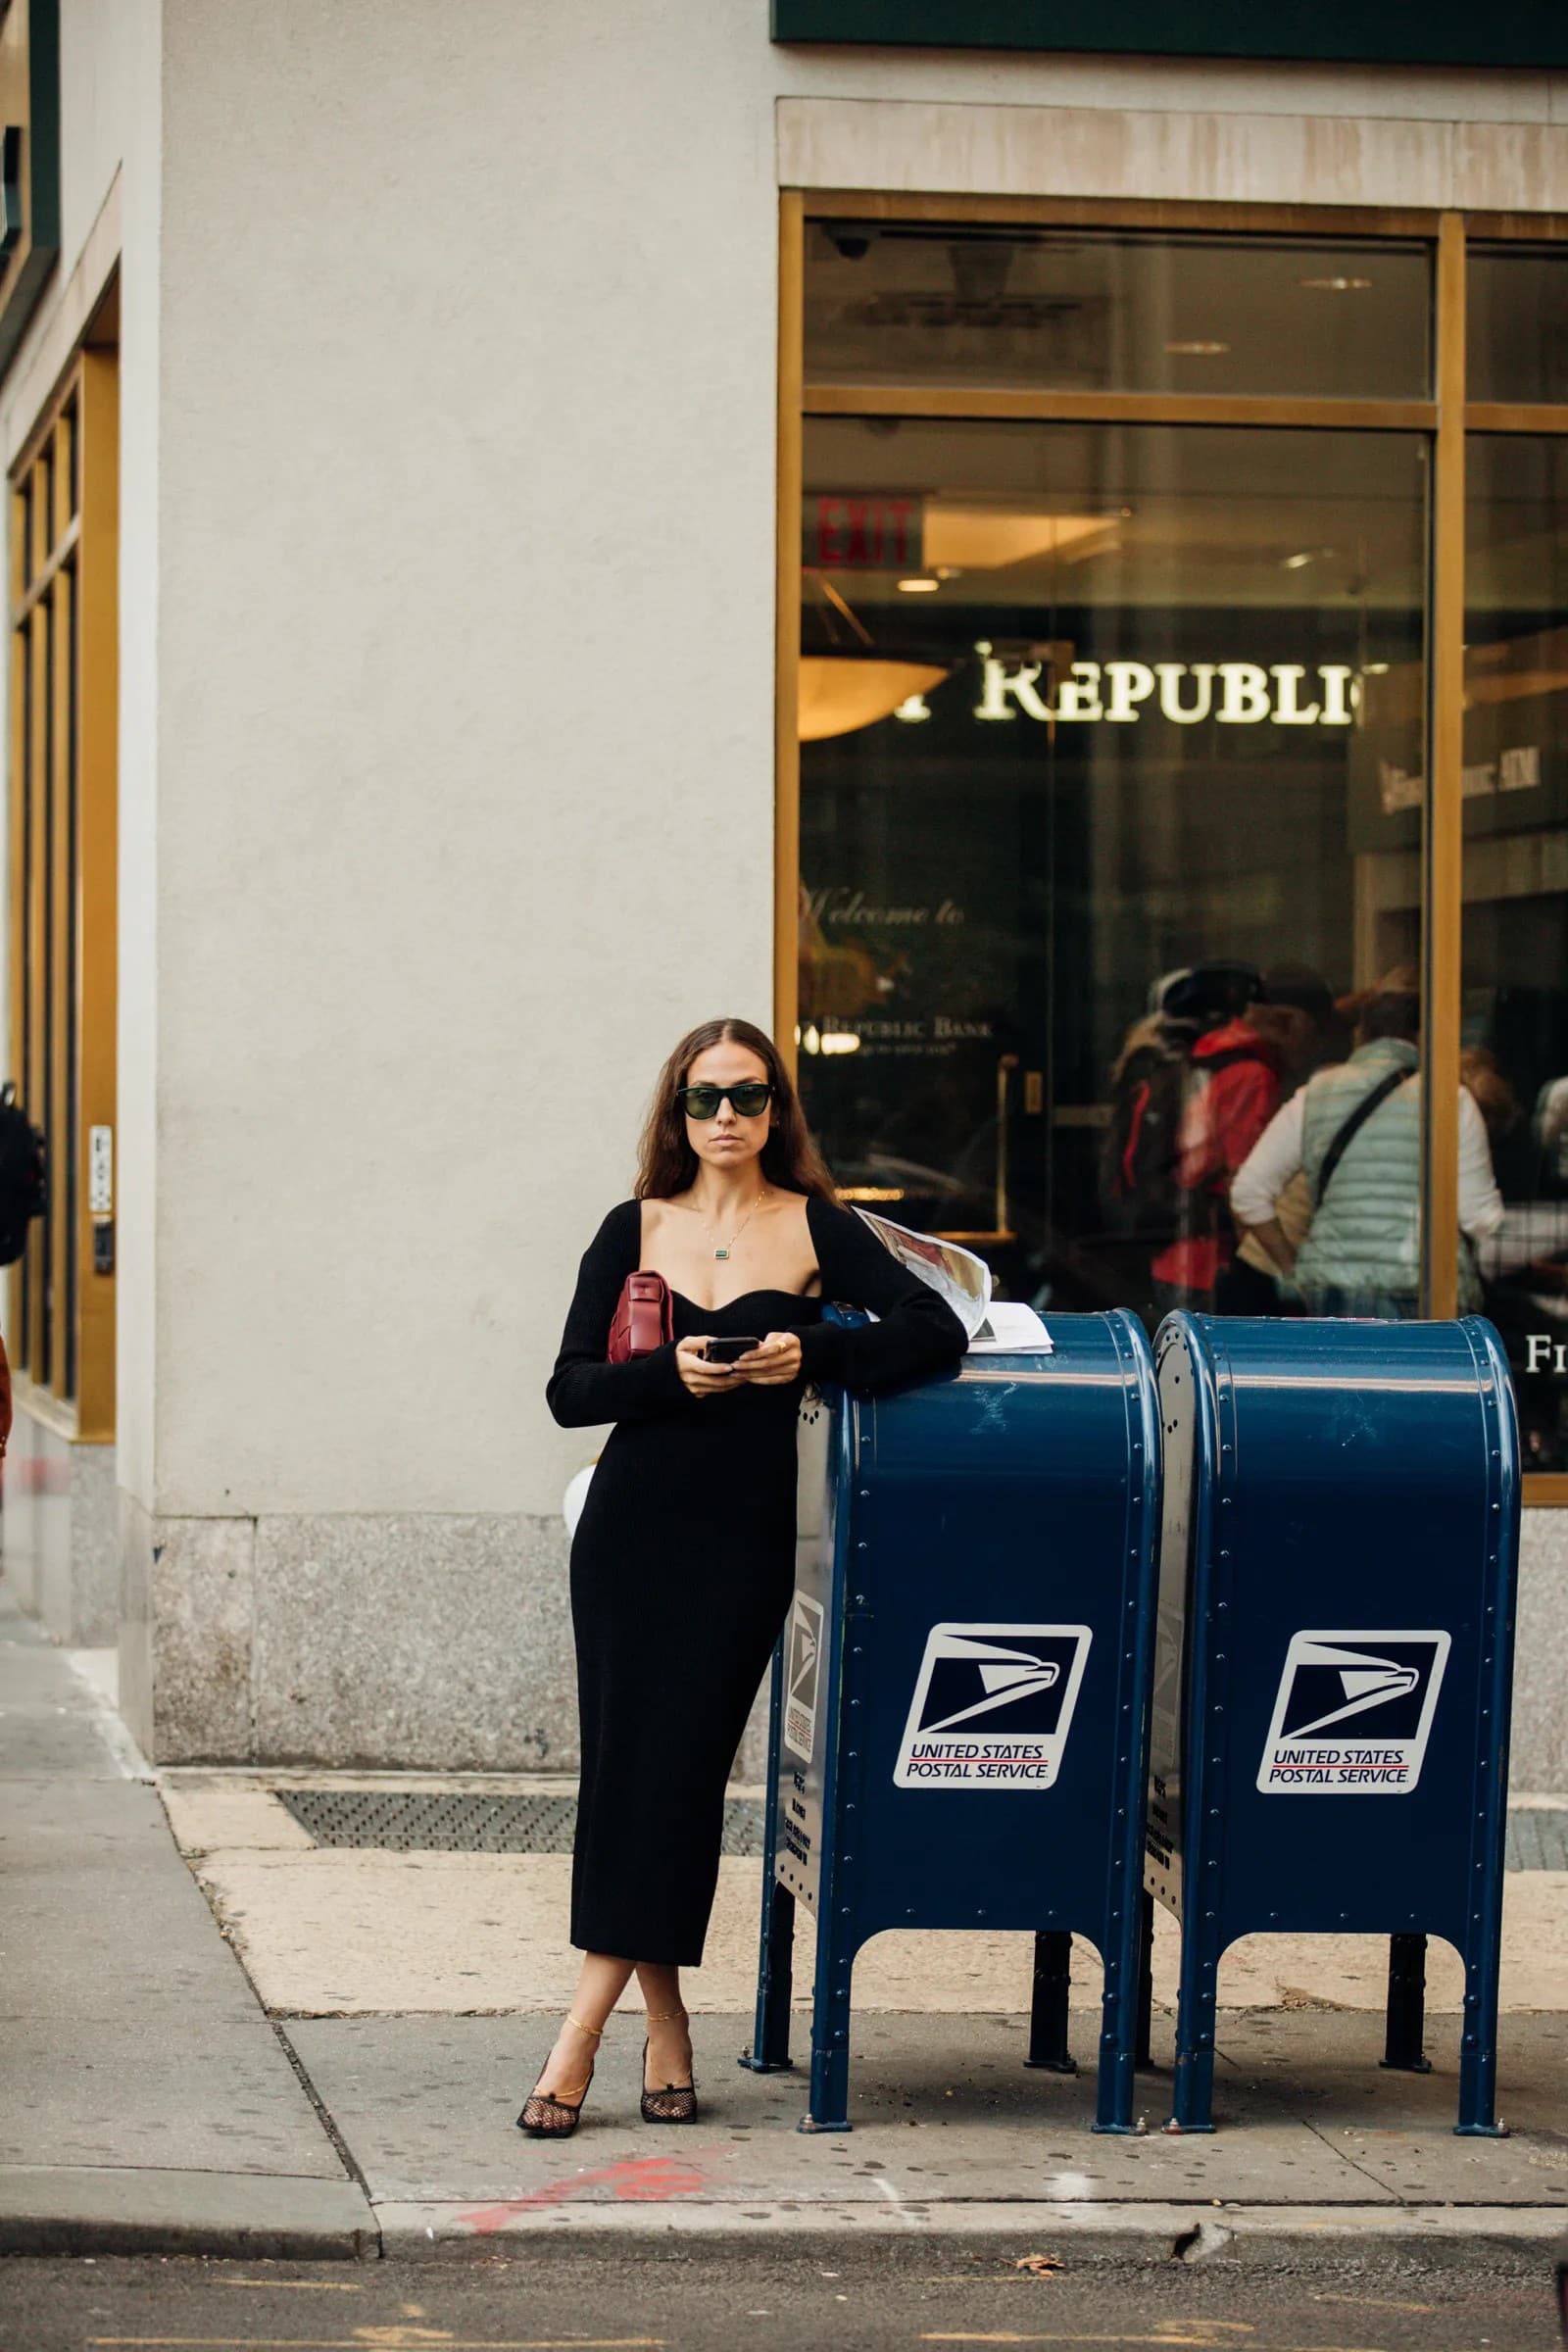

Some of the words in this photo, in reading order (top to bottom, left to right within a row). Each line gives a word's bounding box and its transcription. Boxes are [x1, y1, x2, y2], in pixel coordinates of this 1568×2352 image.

[817, 496, 913, 565] EXIT
[974, 640, 1389, 726] REPUBLI
[910, 1743, 979, 1759] UNITED
[981, 1744, 1044, 1760] STATES
[1274, 1749, 1341, 1765] UNITED
[1343, 1750, 1404, 1765] STATES
[906, 1763, 972, 1778] POSTAL
[975, 1764, 1048, 1779] SERVICE
[1268, 1769, 1334, 1784] POSTAL
[1337, 1769, 1409, 1784] SERVICE
